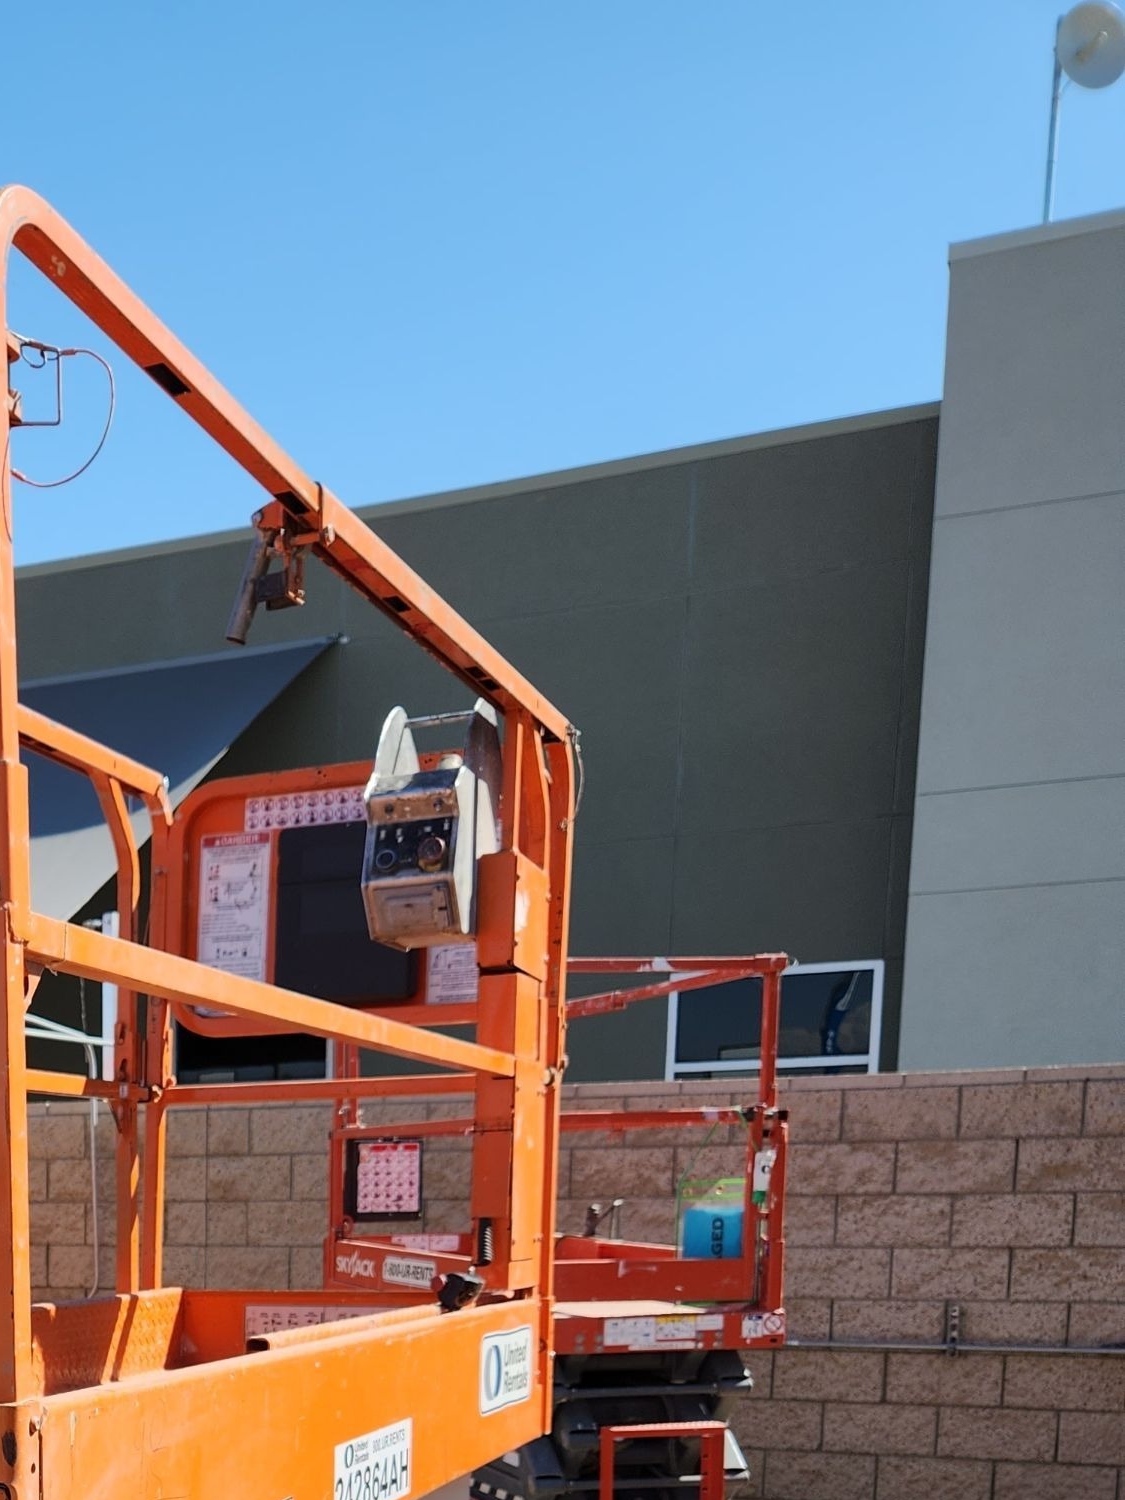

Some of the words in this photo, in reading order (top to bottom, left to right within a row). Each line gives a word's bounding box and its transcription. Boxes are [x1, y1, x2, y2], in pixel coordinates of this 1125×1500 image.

[711, 1217, 724, 1258] GED
[336, 1250, 374, 1278] SKYJACK
[505, 1339, 528, 1366] United
[504, 1371, 528, 1393] Rentals
